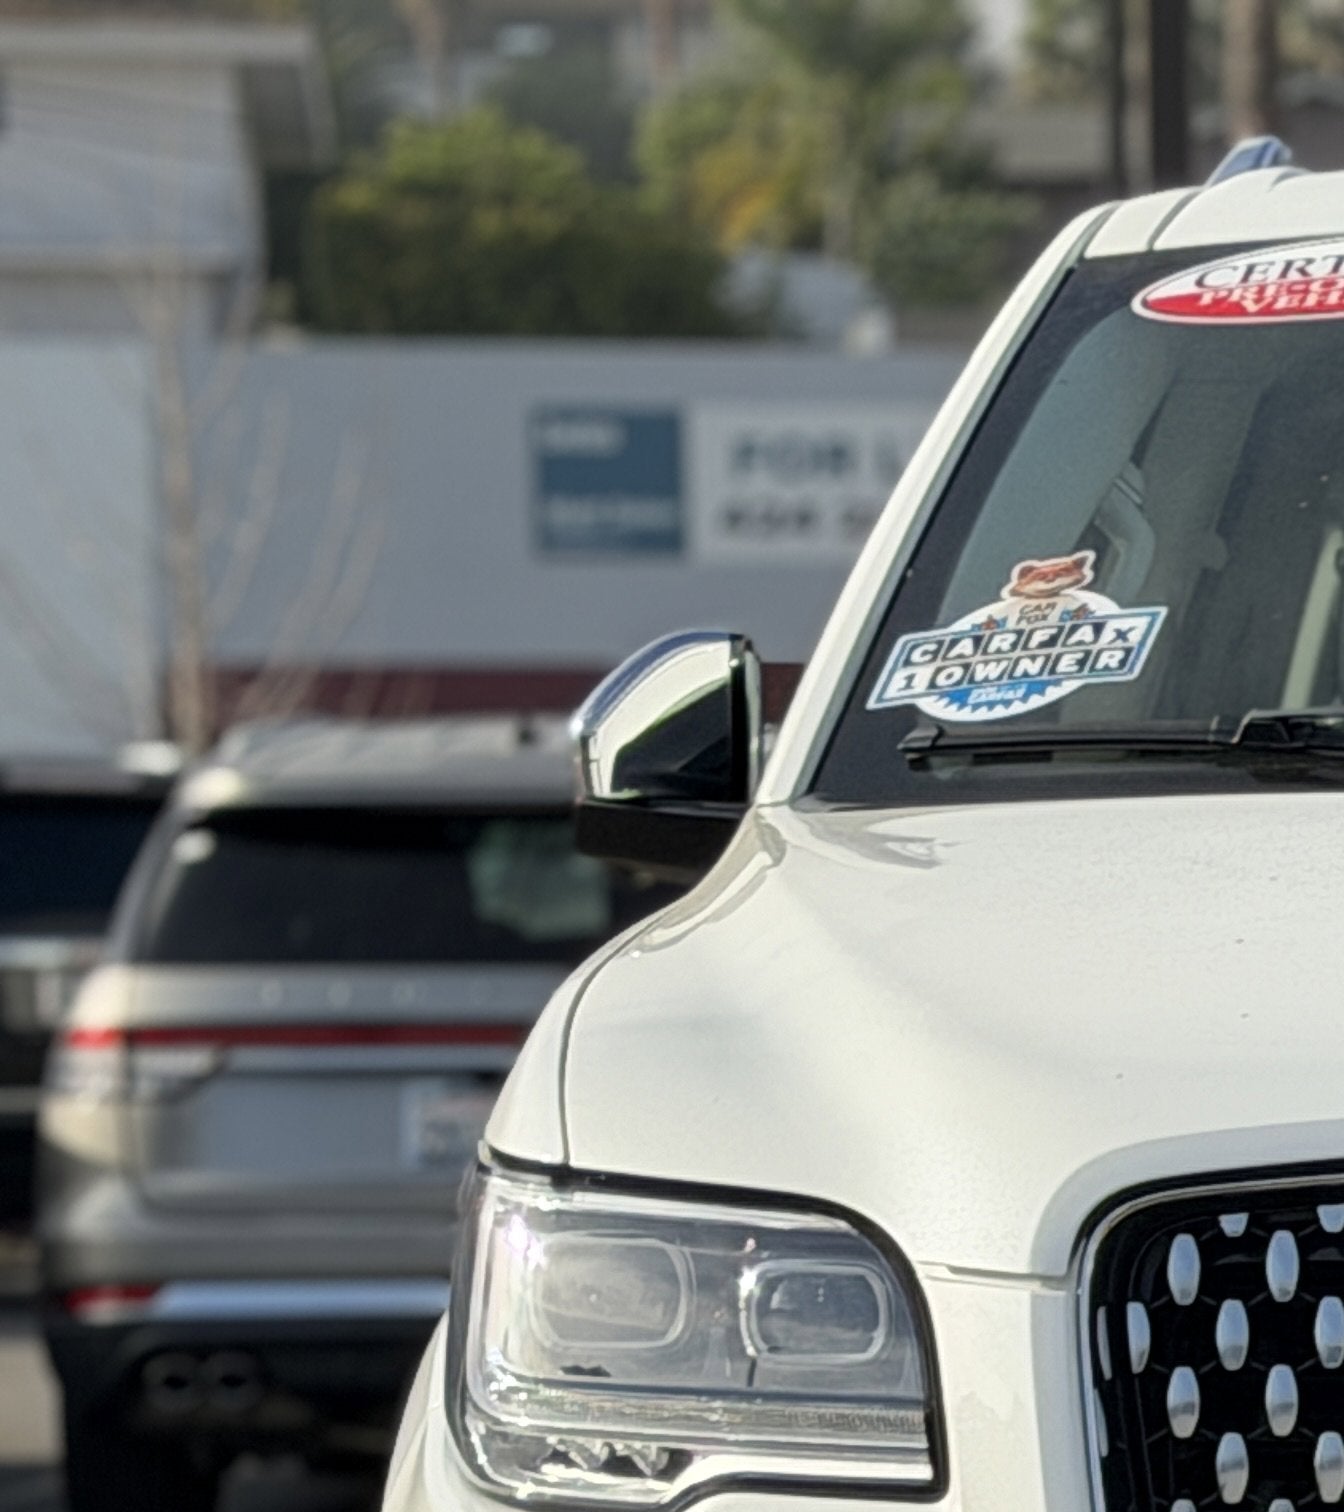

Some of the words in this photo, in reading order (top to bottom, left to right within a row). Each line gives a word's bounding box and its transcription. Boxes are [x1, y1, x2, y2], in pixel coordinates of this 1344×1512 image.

[908, 623, 1136, 664] CARFAX
[895, 669, 918, 692] 1
[935, 649, 1126, 687] OWNER
